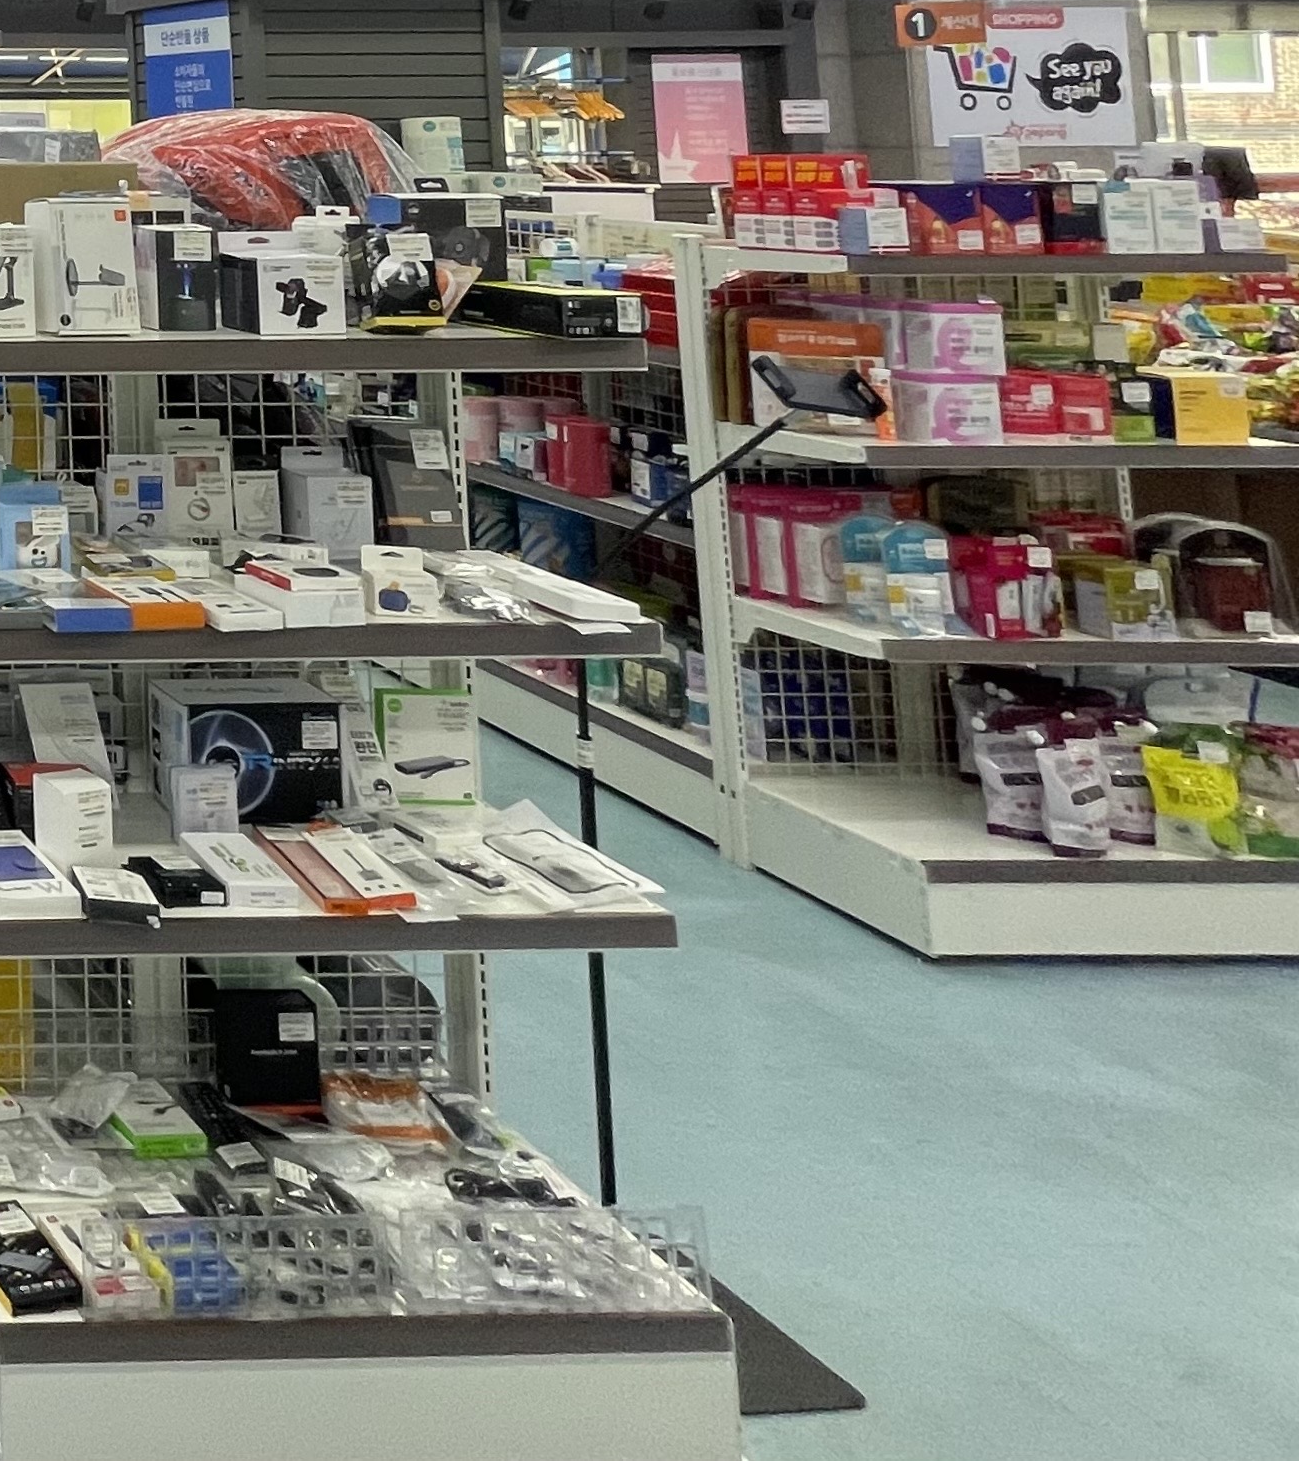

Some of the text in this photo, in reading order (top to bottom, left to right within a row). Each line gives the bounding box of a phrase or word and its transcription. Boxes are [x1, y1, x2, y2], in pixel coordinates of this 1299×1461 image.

[911, 12, 925, 37] 1
[1047, 58, 1113, 80] See you
[1052, 79, 1103, 104] again!
